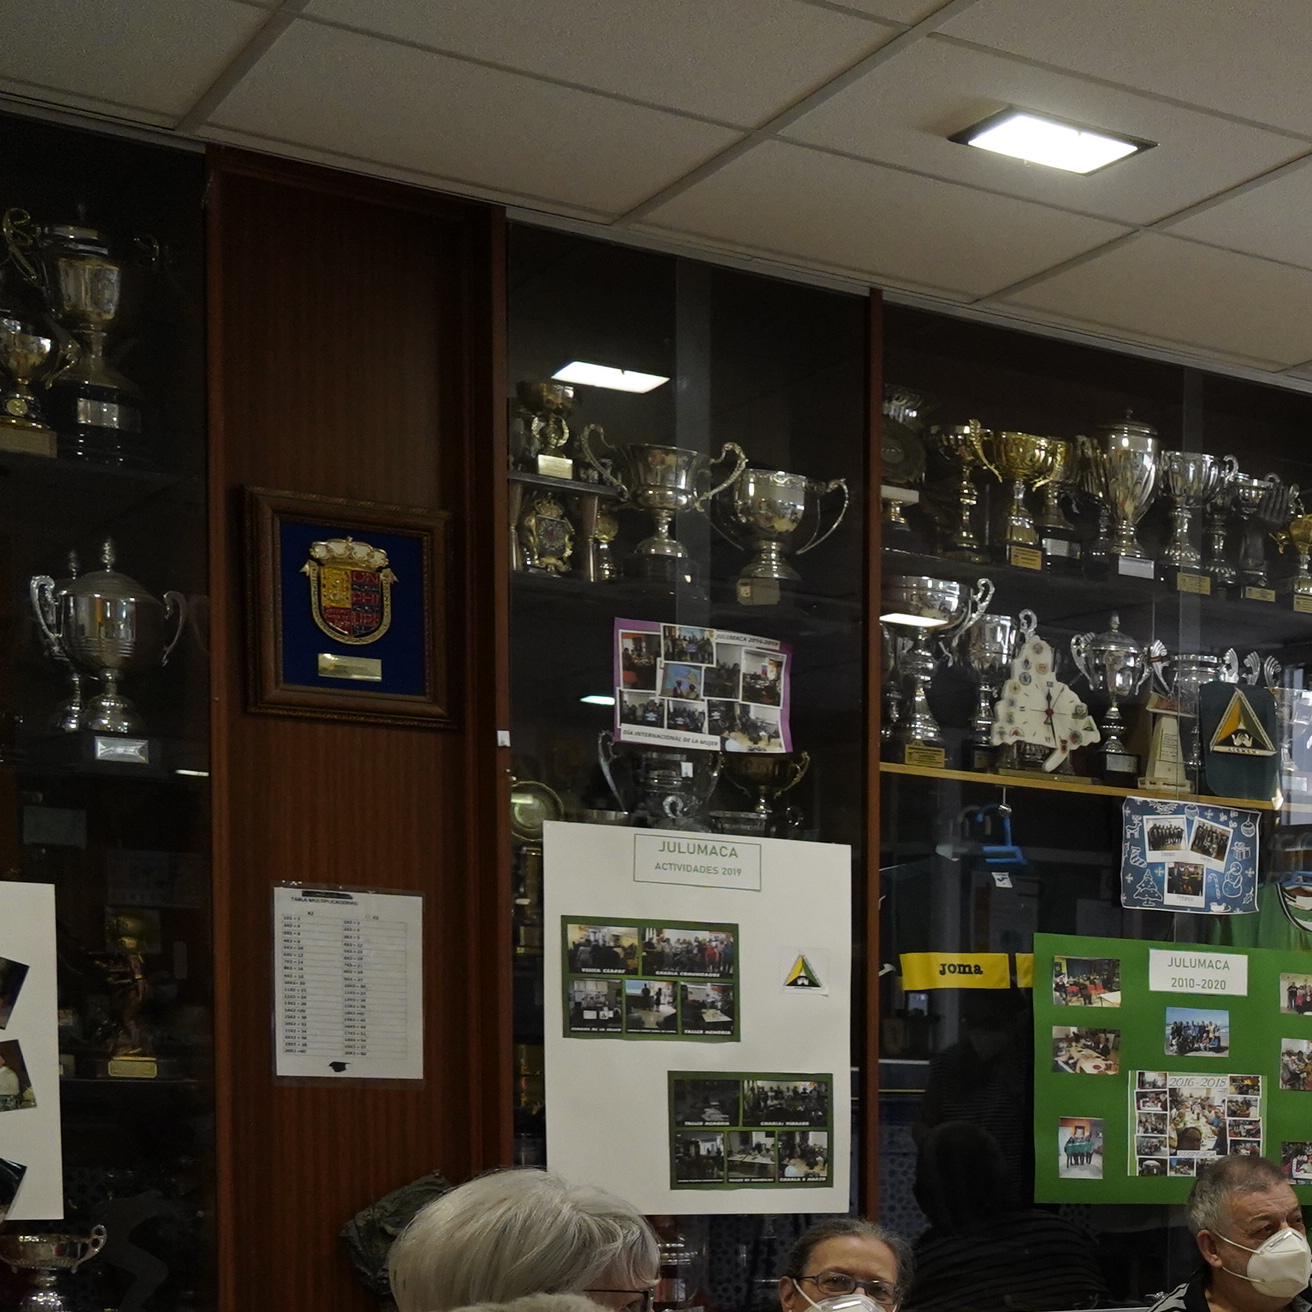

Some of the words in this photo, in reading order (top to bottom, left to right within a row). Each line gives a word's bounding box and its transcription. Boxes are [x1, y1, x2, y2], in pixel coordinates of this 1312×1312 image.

[658, 840, 739, 859] JULUMACA
[655, 862, 719, 876] ACTIVIDADES
[722, 866, 742, 877] 2019
[1167, 956, 1231, 972] JULUMACA
[1171, 976, 1227, 992] 2010-2020
